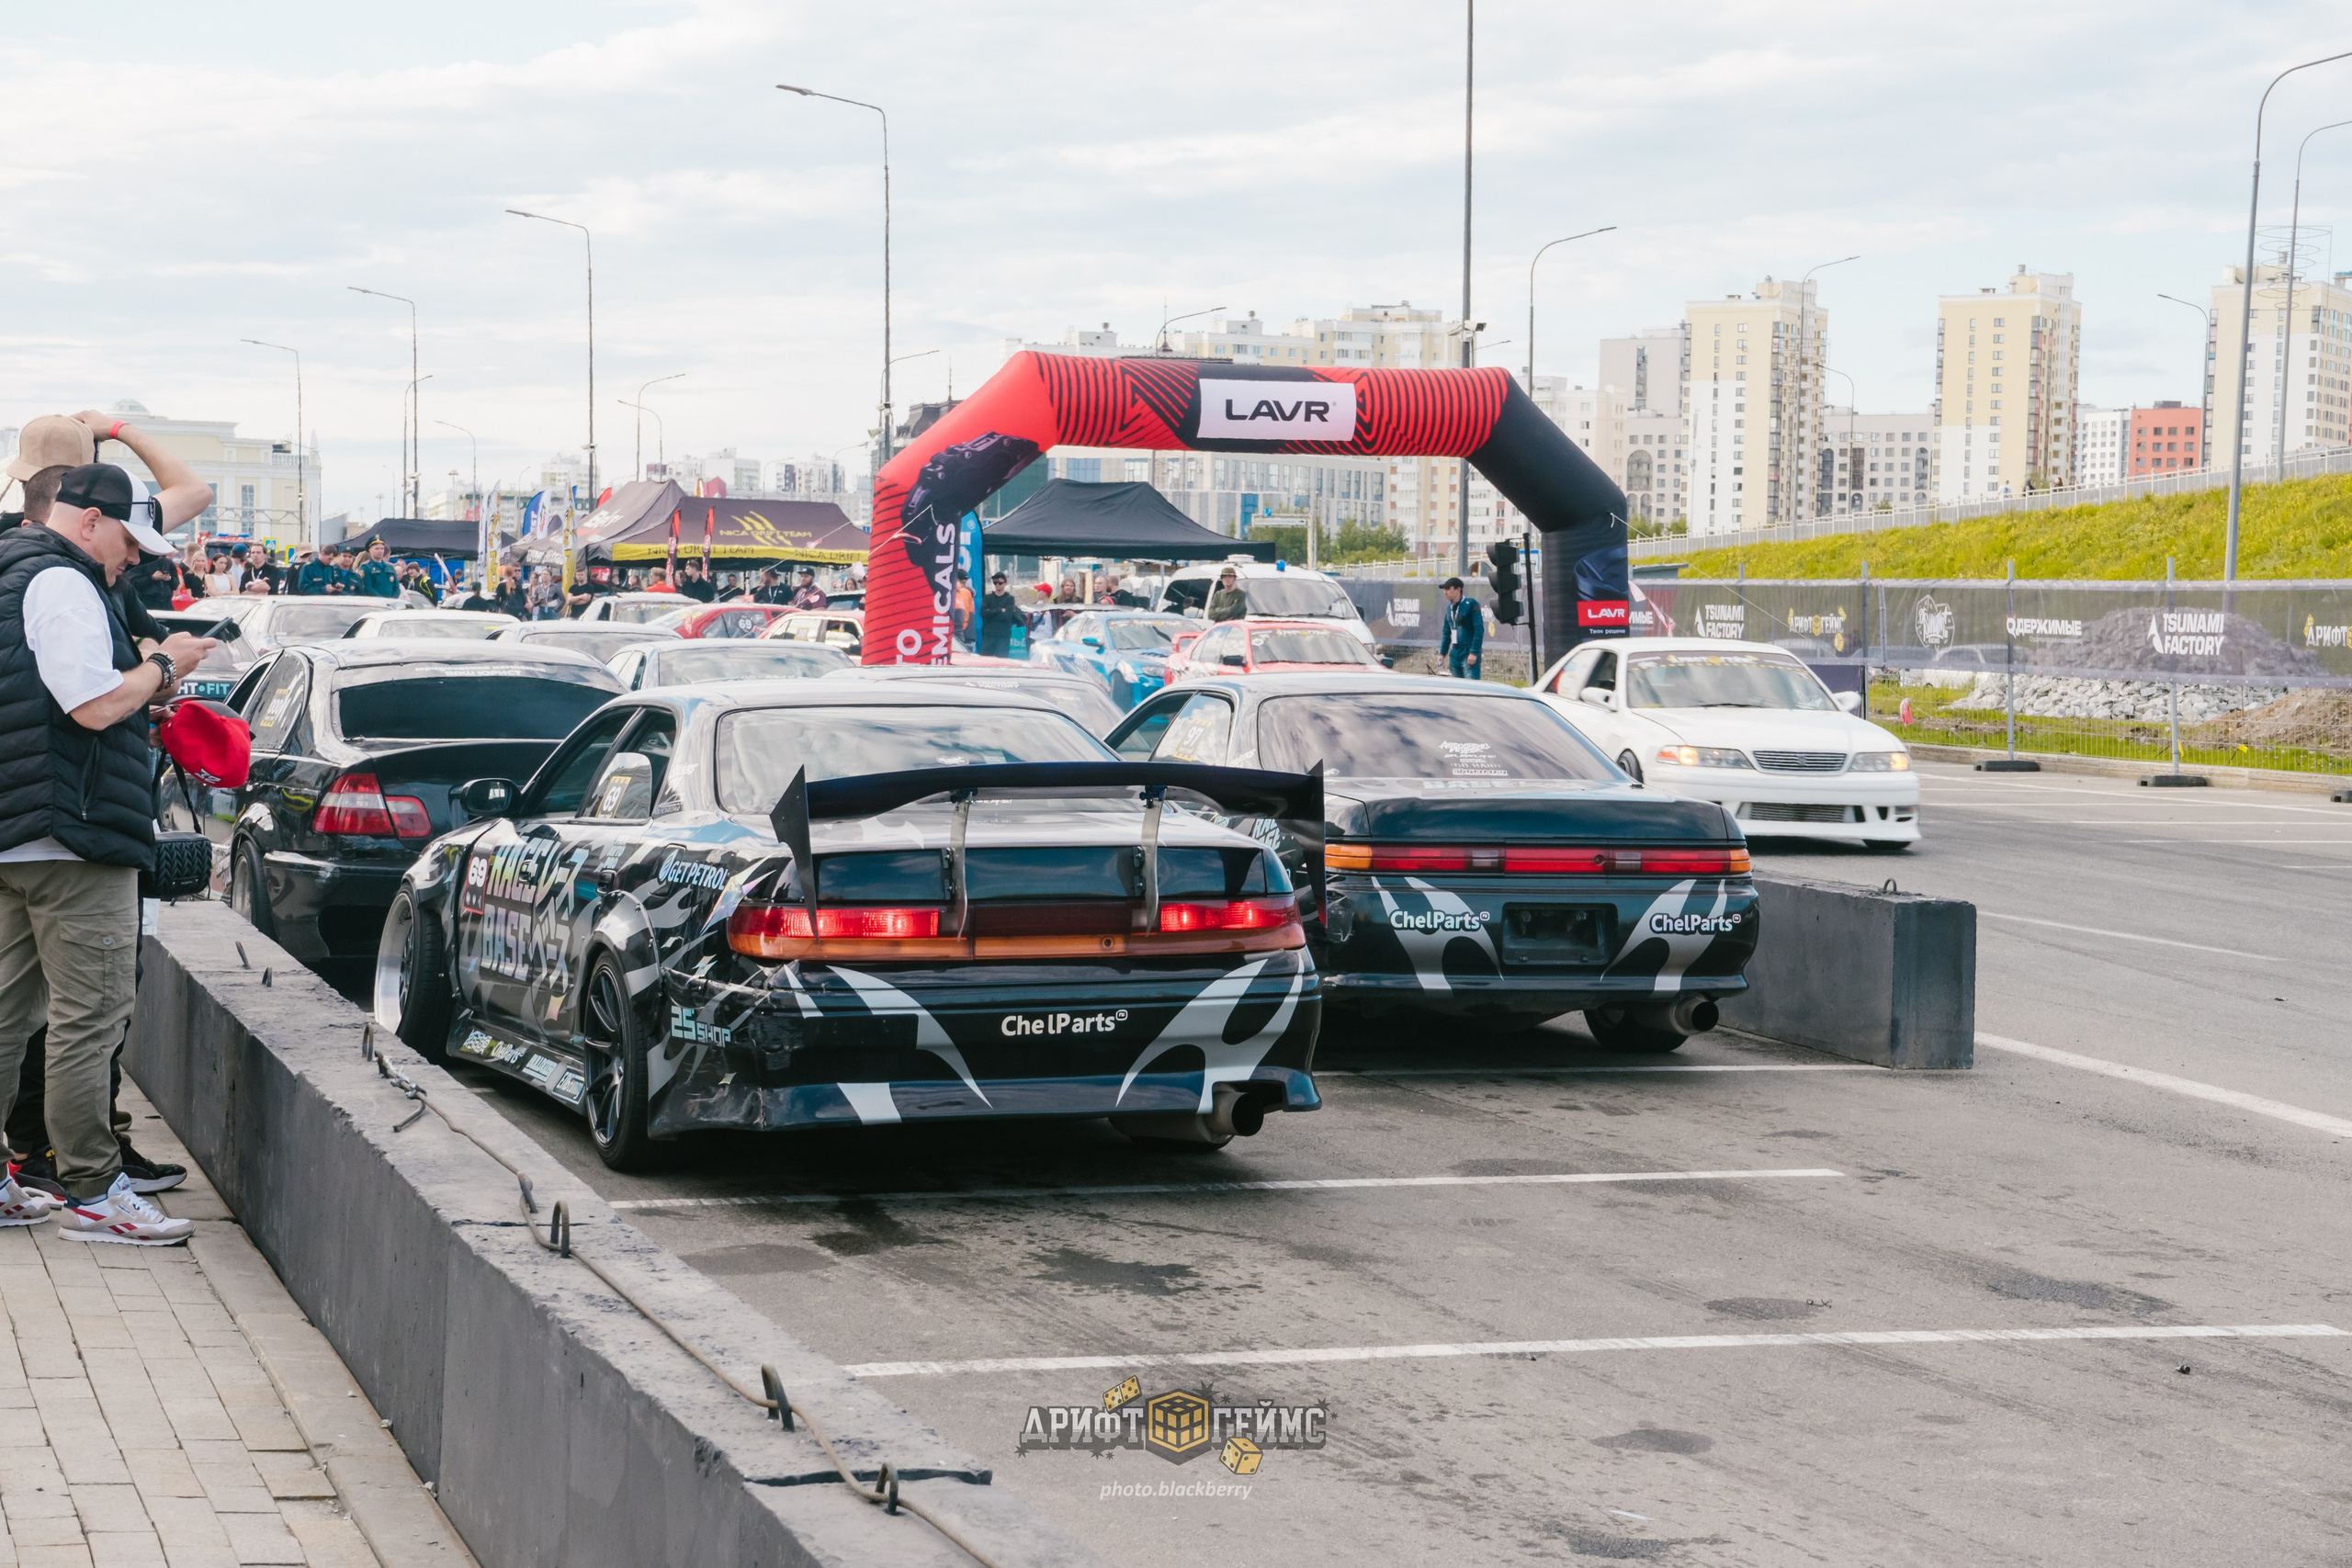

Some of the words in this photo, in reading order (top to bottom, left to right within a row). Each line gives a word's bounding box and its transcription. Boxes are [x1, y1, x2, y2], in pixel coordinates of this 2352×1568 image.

[1226, 399, 1329, 422] LAVR
[784, 530, 812, 538] TEAM
[1588, 608, 1625, 619] LAVR
[1705, 604, 1744, 621] TSUNAMI
[738, 618, 752, 630] 69
[1705, 623, 1744, 639] FACTORY
[1820, 614, 1844, 633] ГЕЙМС
[2163, 614, 2224, 633] TSUNAMI
[2164, 636, 2224, 655] FACTORY
[2306, 626, 2347, 647] ДРИФТ
[1182, 726, 1204, 748] 97
[603, 785, 622, 812] 69
[468, 856, 489, 887] 69
[1390, 910, 1480, 930] ChelParts
[1651, 914, 1733, 932] ChelParts
[481, 903, 532, 982] BASE
[671, 1005, 696, 1041] 25
[696, 1021, 731, 1047] SHOP
[1001, 1012, 1115, 1036] ChelParts
